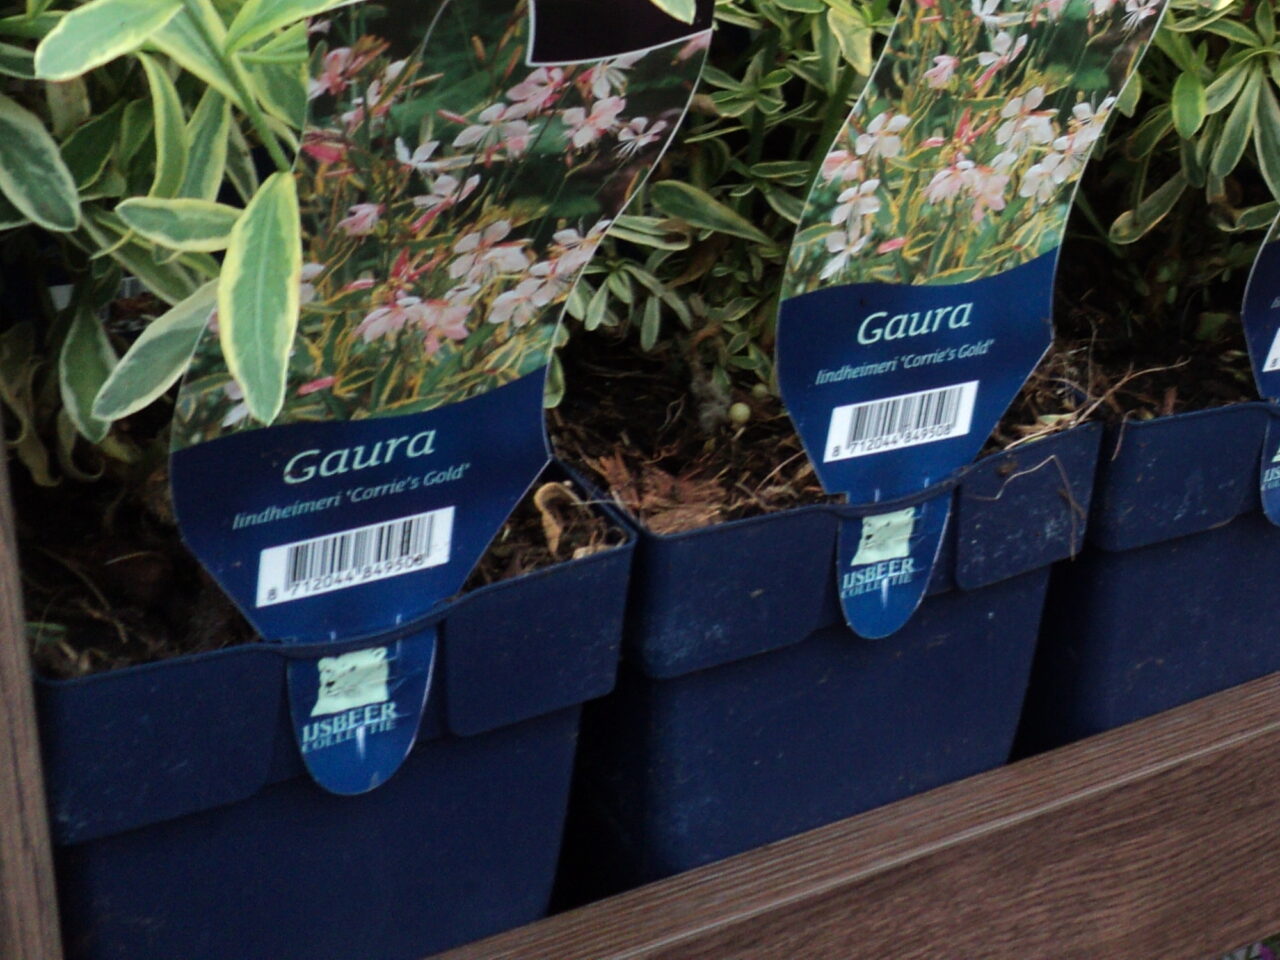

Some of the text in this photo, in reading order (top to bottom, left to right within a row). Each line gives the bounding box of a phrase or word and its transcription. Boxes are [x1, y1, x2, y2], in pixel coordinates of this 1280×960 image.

[857, 302, 974, 345] Gaura
[815, 356, 900, 386] lindheimeri
[283, 429, 436, 484] Gaura
[832, 424, 952, 458] 8 712044 849508
[232, 493, 341, 530] lindheimeri
[267, 588, 277, 601] 8
[290, 572, 353, 597] 712044
